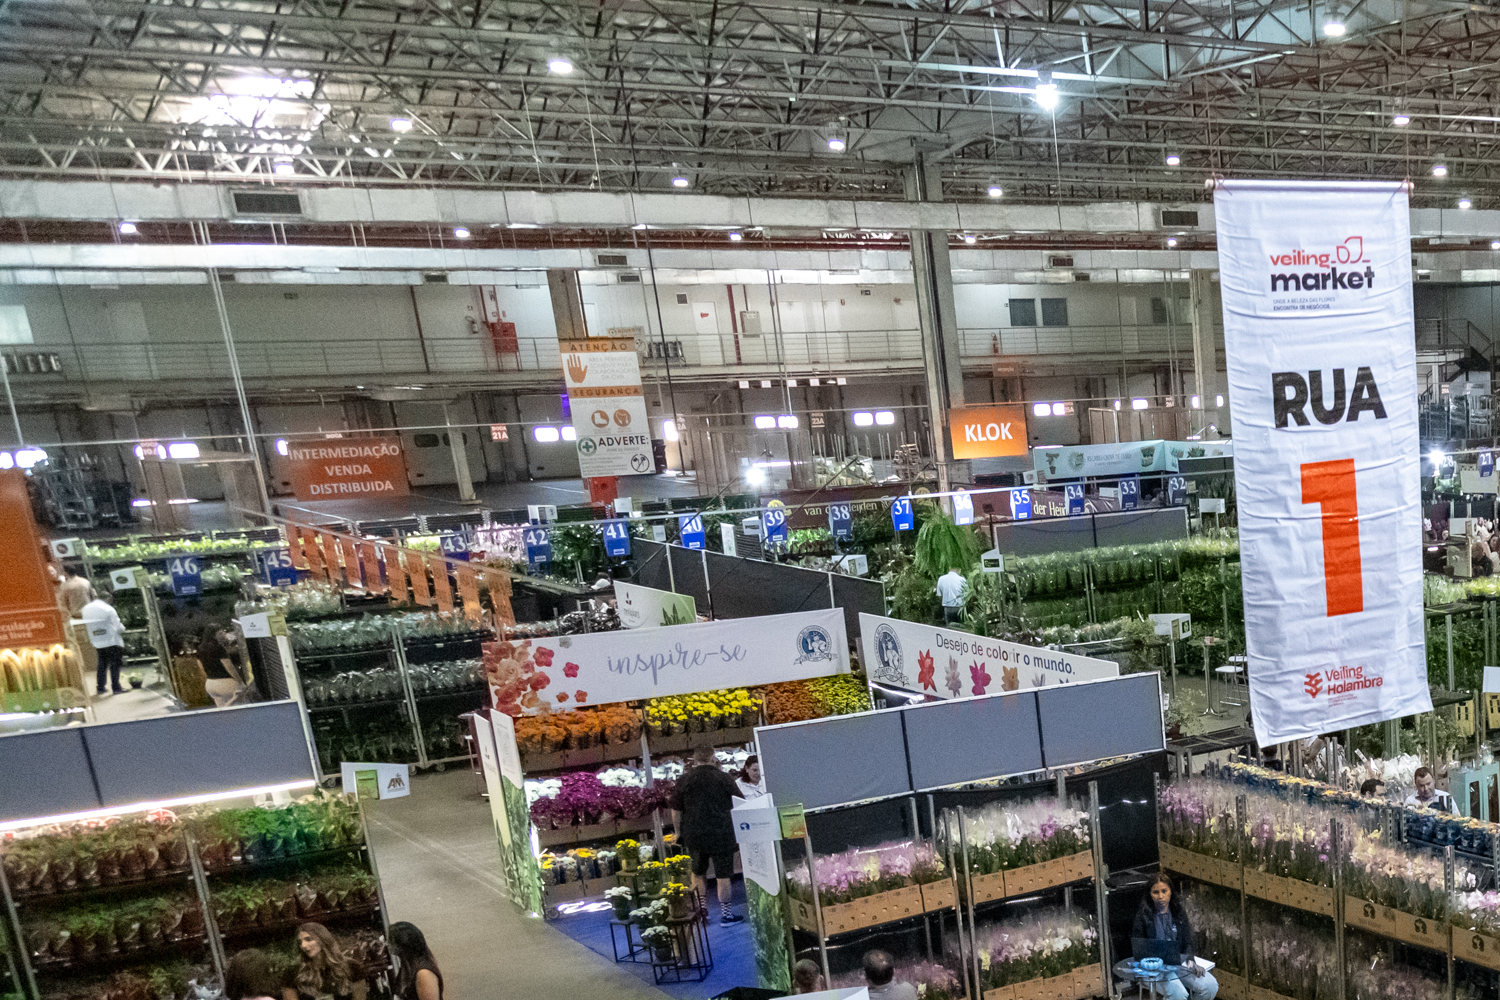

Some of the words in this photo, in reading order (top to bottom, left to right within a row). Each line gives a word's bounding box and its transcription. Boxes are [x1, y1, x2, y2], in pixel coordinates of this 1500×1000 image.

[1270, 249, 1330, 269] veiling
[1271, 266, 1375, 292] market
[570, 341, 628, 353] ATENÇÃO
[1272, 366, 1388, 429] RUA
[492, 431, 508, 440] 21A
[965, 422, 1013, 442] KLOK
[598, 435, 650, 447] ADVERTE:
[288, 443, 400, 460] INTERMEDIAÇÃO
[1480, 453, 1491, 465] 27
[325, 464, 372, 477] VENDA
[310, 480, 394, 495] DISTRIBUIDA
[1067, 486, 1084, 500] 34
[1121, 481, 1137, 495] 33
[1012, 489, 1030, 504] 35
[804, 506, 822, 516] van
[832, 504, 850, 520] 38
[894, 500, 910, 516] 37
[1033, 501, 1047, 516] der
[681, 515, 702, 533] 40
[766, 510, 785, 525] 39
[526, 528, 549, 546] 42
[605, 522, 627, 539] 41
[1300, 458, 1363, 617] 1
[443, 536, 466, 552] 43
[171, 558, 198, 576] 46
[267, 552, 293, 569] 45
[936, 633, 969, 656] Desejo
[971, 640, 983, 655] de
[986, 645, 1020, 664] colorir
[1023, 654, 1030, 666] o
[1033, 657, 1076, 676] mundo.
[607, 642, 747, 686] inspire-se
[1325, 665, 1363, 681] Veiling
[1327, 676, 1383, 695] Holambra
